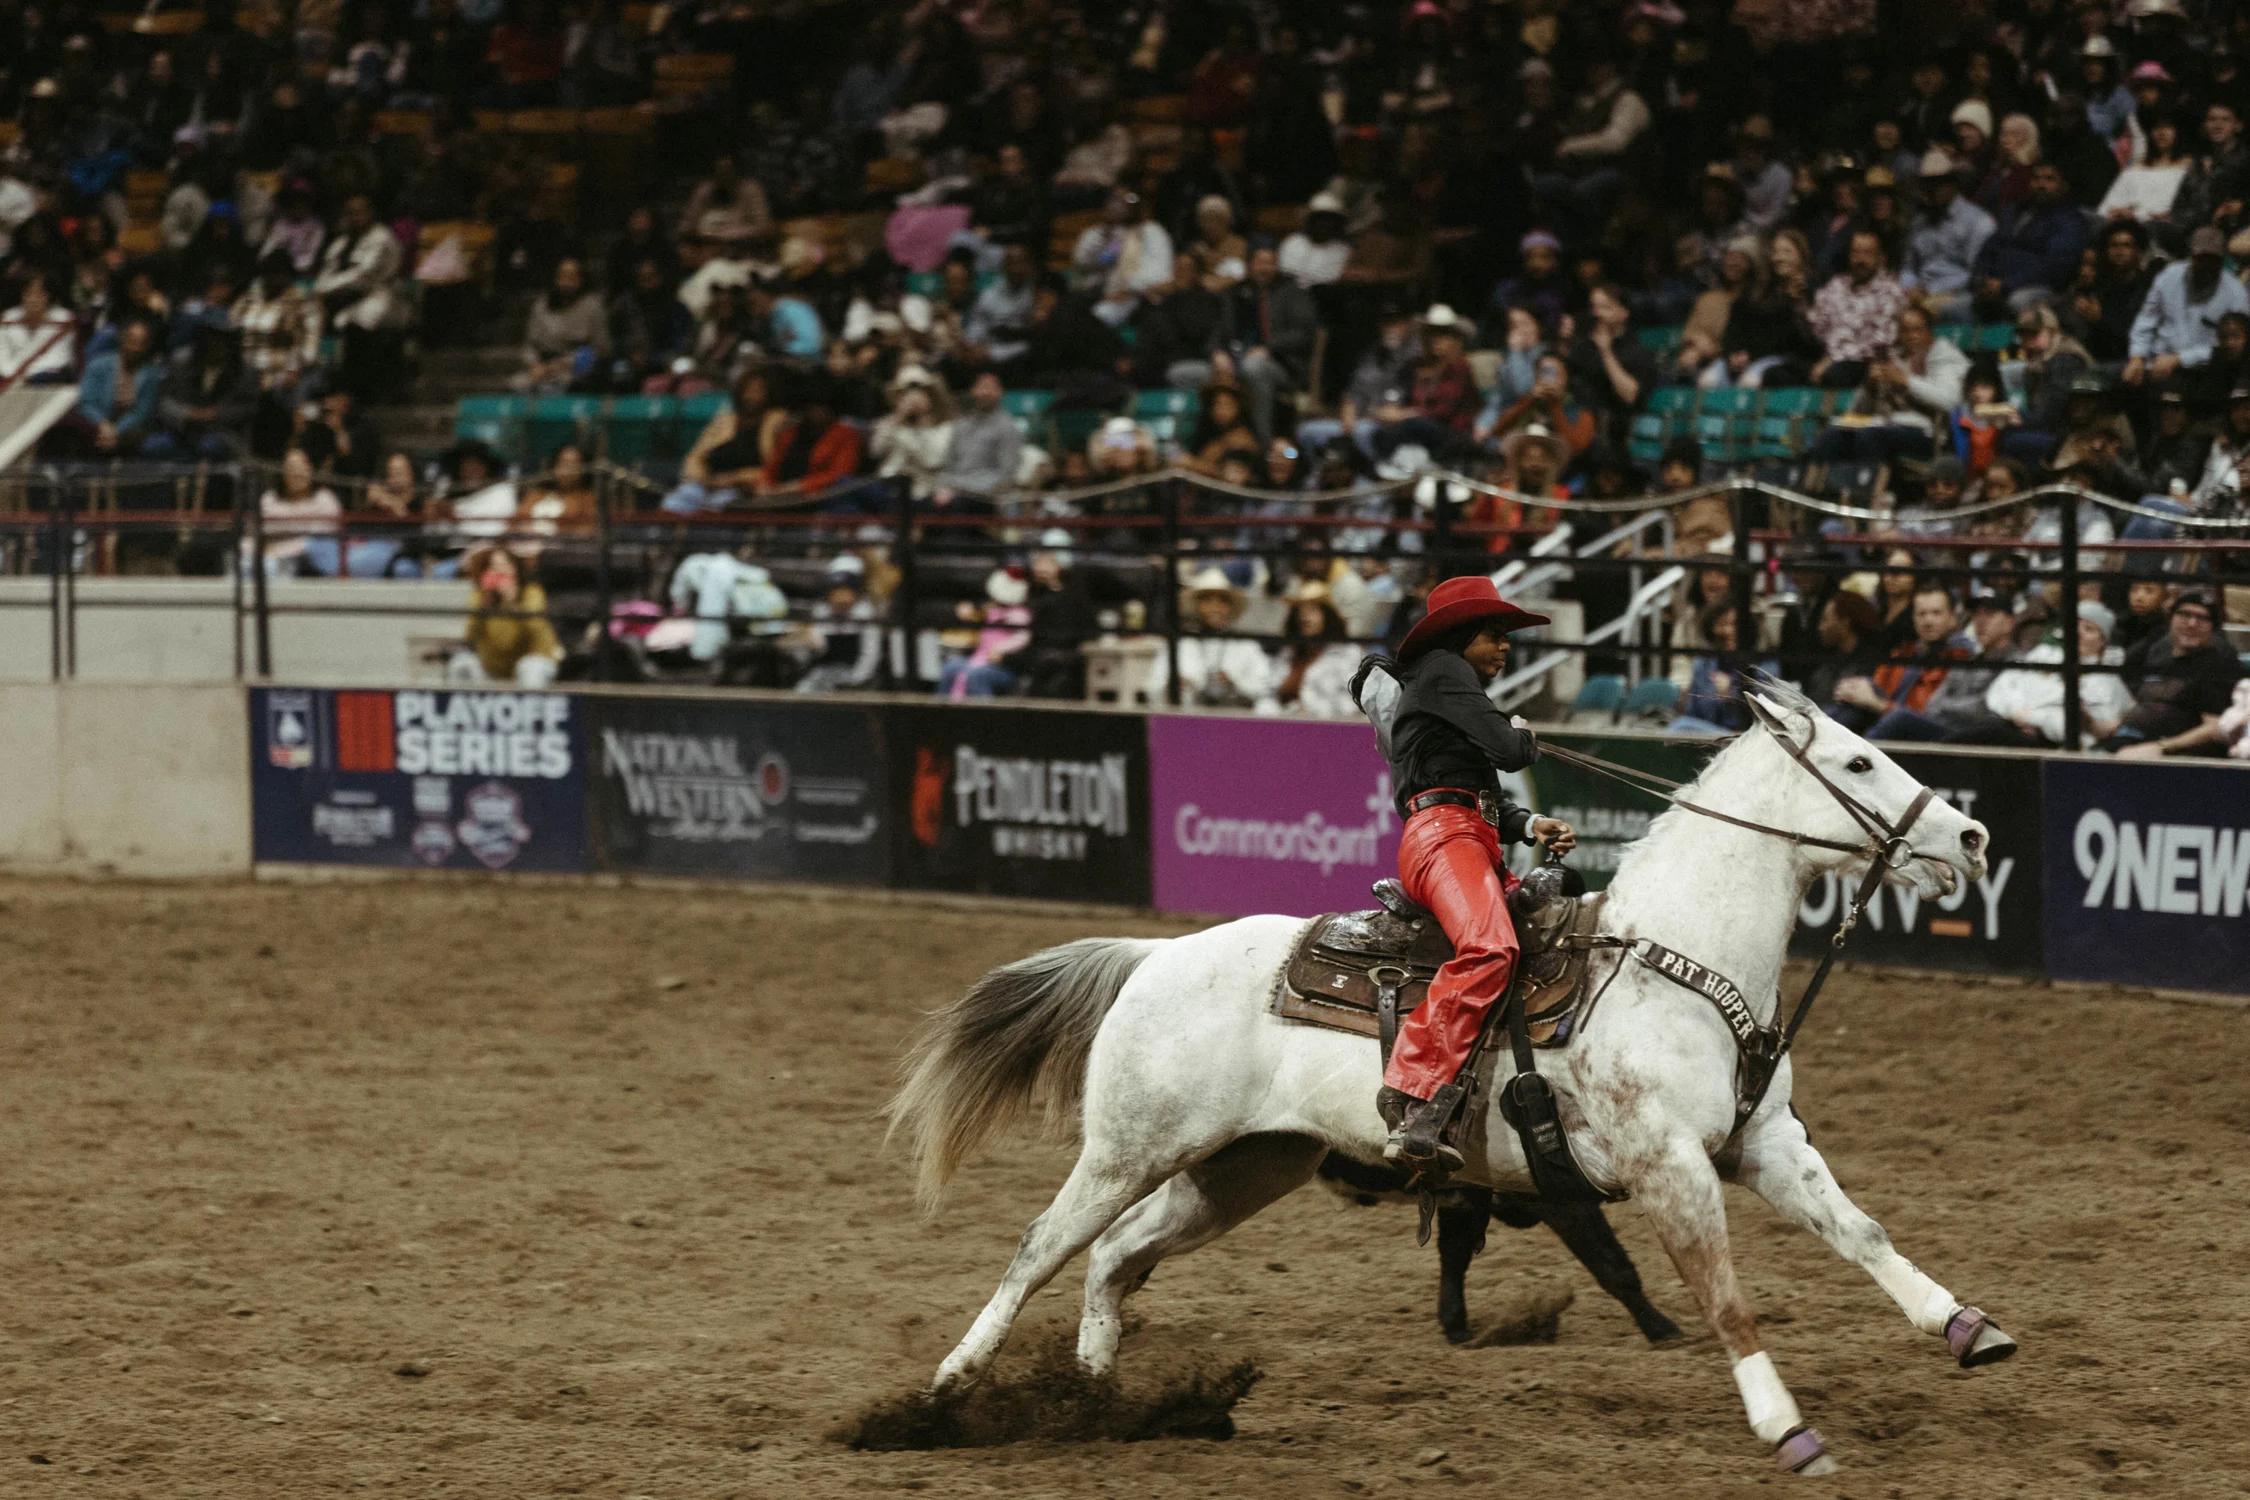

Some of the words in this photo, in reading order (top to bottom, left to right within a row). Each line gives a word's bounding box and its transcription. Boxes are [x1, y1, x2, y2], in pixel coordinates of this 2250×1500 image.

[396, 692, 570, 732] PLAYOFF
[396, 728, 573, 779] SERIES
[955, 744, 1129, 837] PENDLETON
[1174, 803, 1379, 877] CommonSpirit
[2073, 807, 2250, 918] 9NEW
[1660, 951, 1701, 983] PAT
[1702, 969, 1756, 1040] HOOPER
